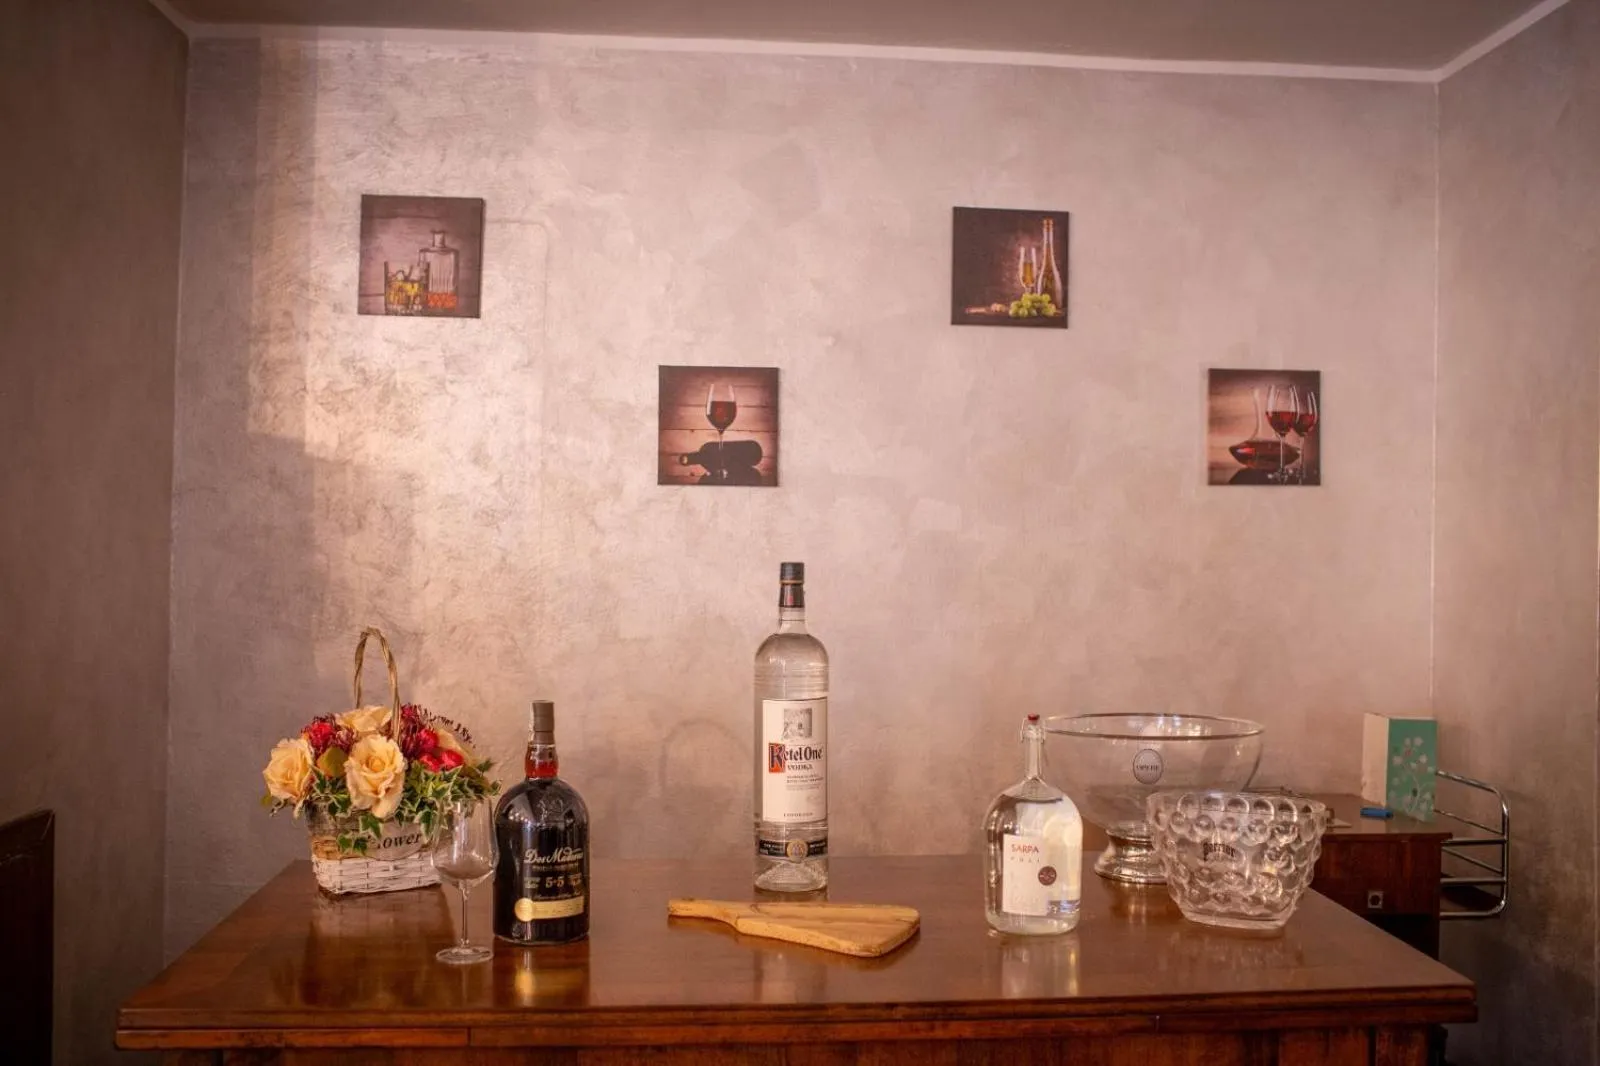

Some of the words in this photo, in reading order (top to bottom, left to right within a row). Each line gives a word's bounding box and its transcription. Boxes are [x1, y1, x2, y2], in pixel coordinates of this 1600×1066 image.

[769, 745, 802, 769] Ketel
[804, 746, 823, 761] One
[524, 848, 545, 863] Dos
[1011, 844, 1040, 853] SARPA
